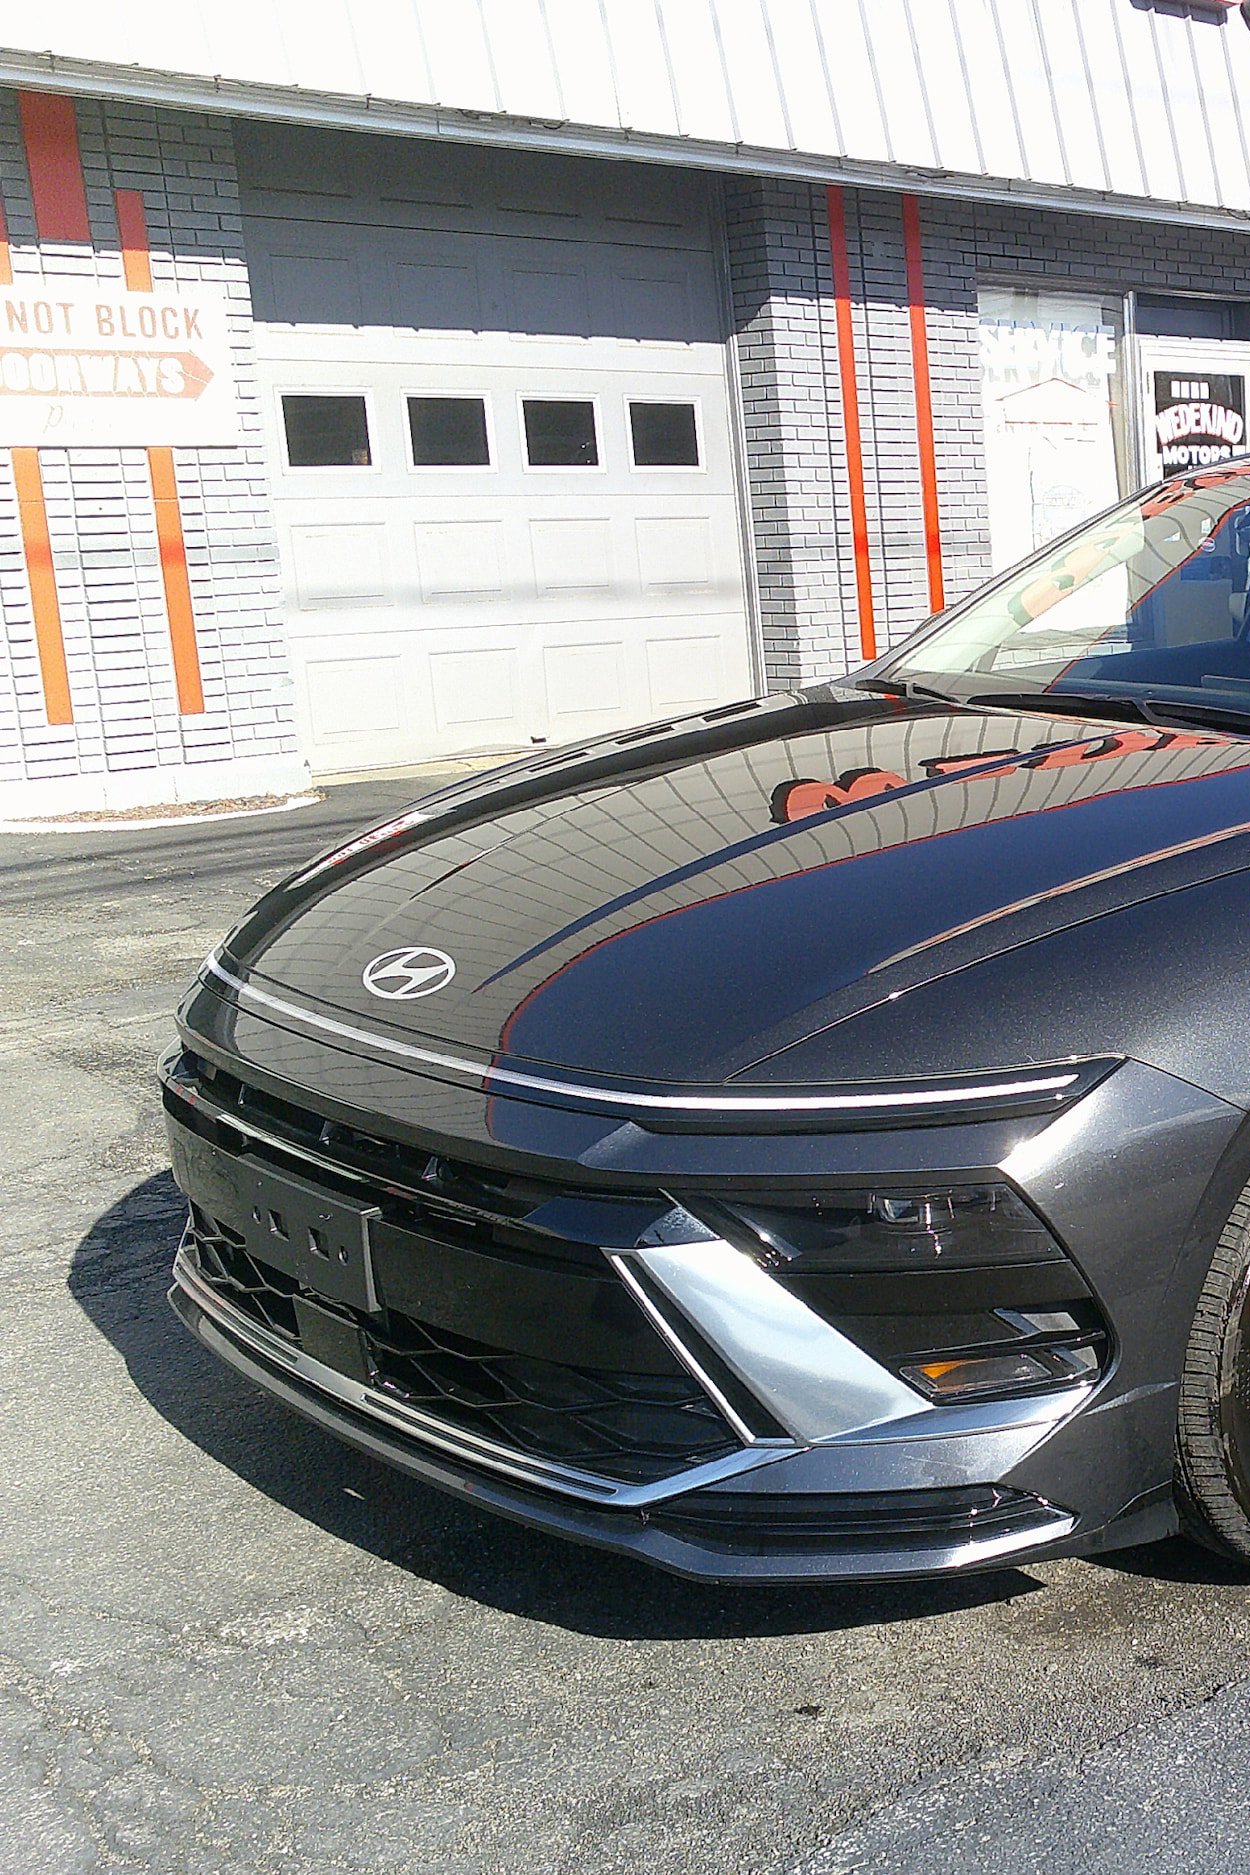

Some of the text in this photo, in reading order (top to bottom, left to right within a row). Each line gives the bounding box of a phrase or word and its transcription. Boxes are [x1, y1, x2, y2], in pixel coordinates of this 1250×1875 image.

[5, 299, 204, 340] NOT BLOCK
[0, 352, 187, 395] OORWAYS
[1156, 402, 1244, 446] WEDEKIND
